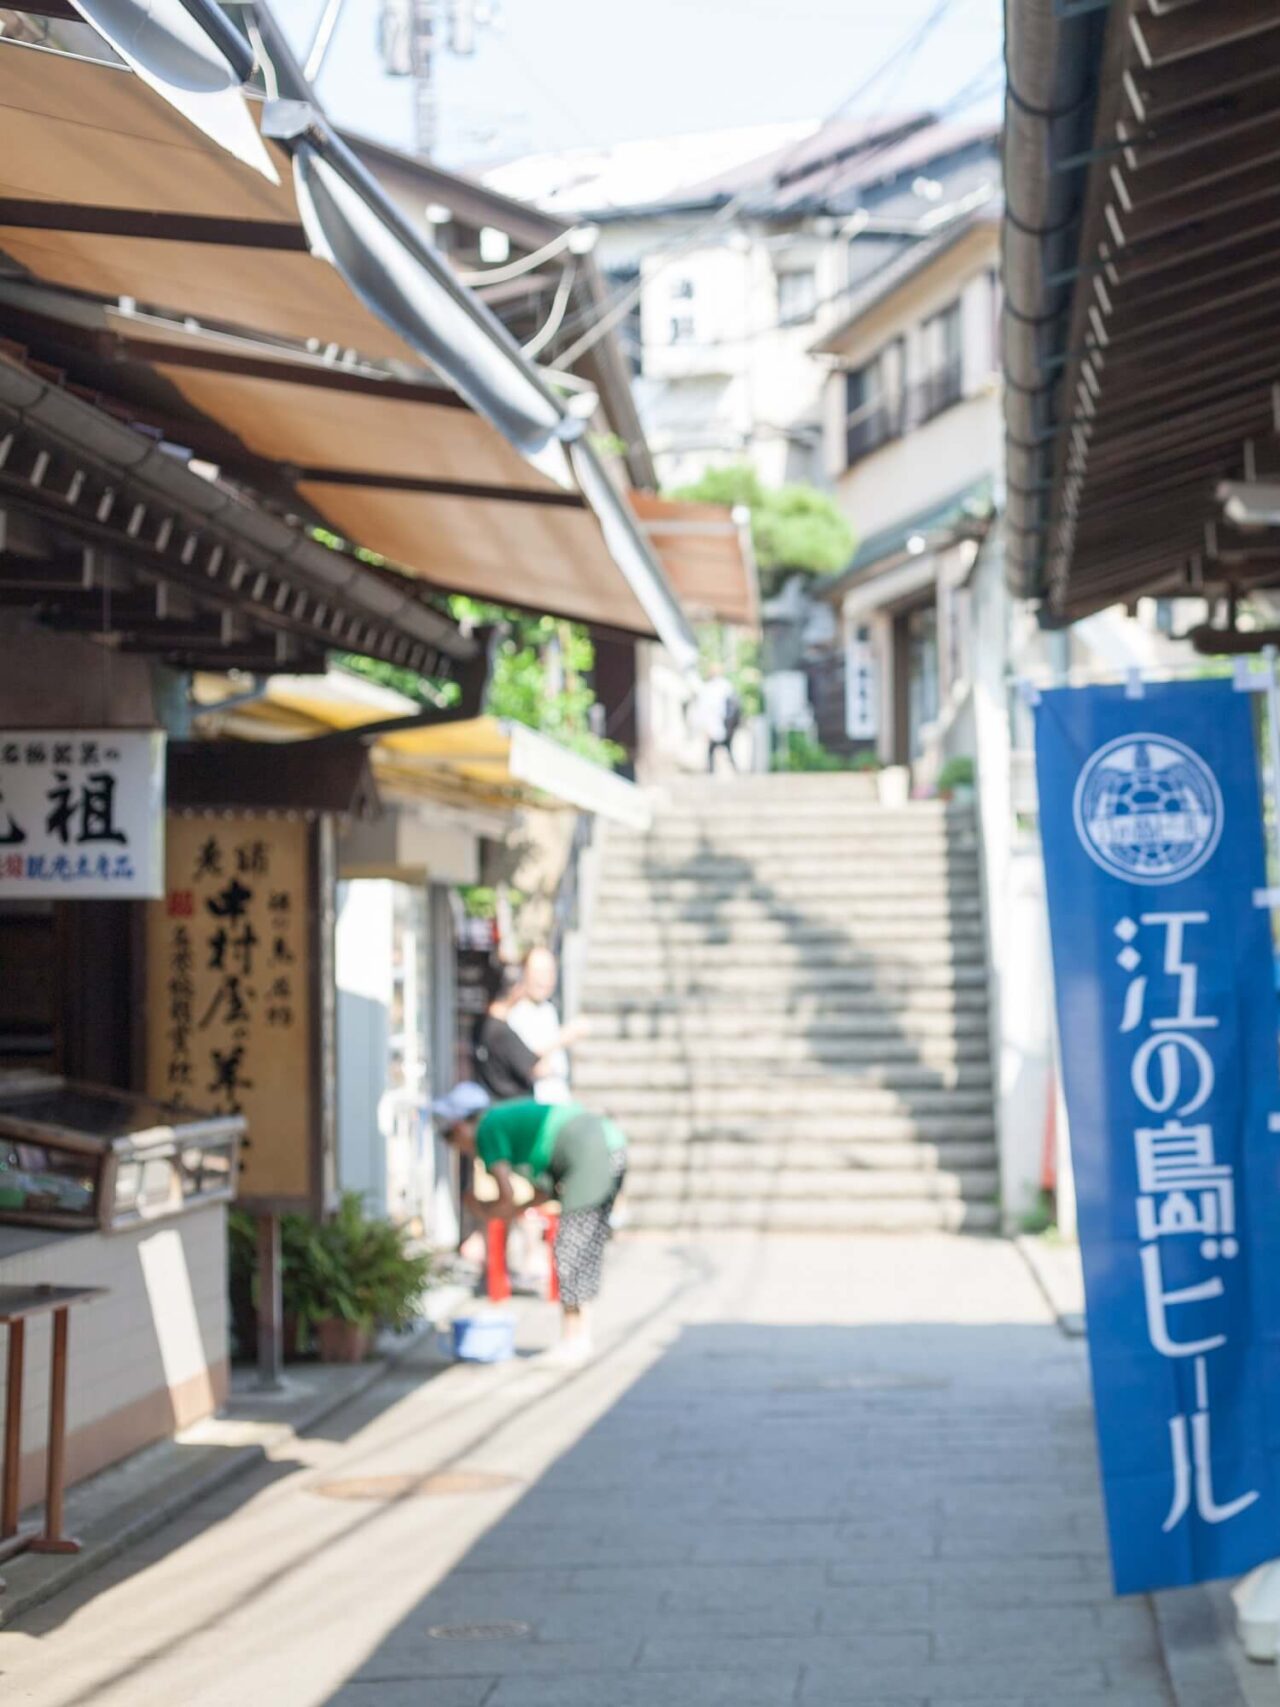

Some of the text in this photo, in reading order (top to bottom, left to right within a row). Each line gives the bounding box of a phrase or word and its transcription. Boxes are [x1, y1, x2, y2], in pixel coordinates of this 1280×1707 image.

[1113, 910, 1260, 1534] 江の島ビール
